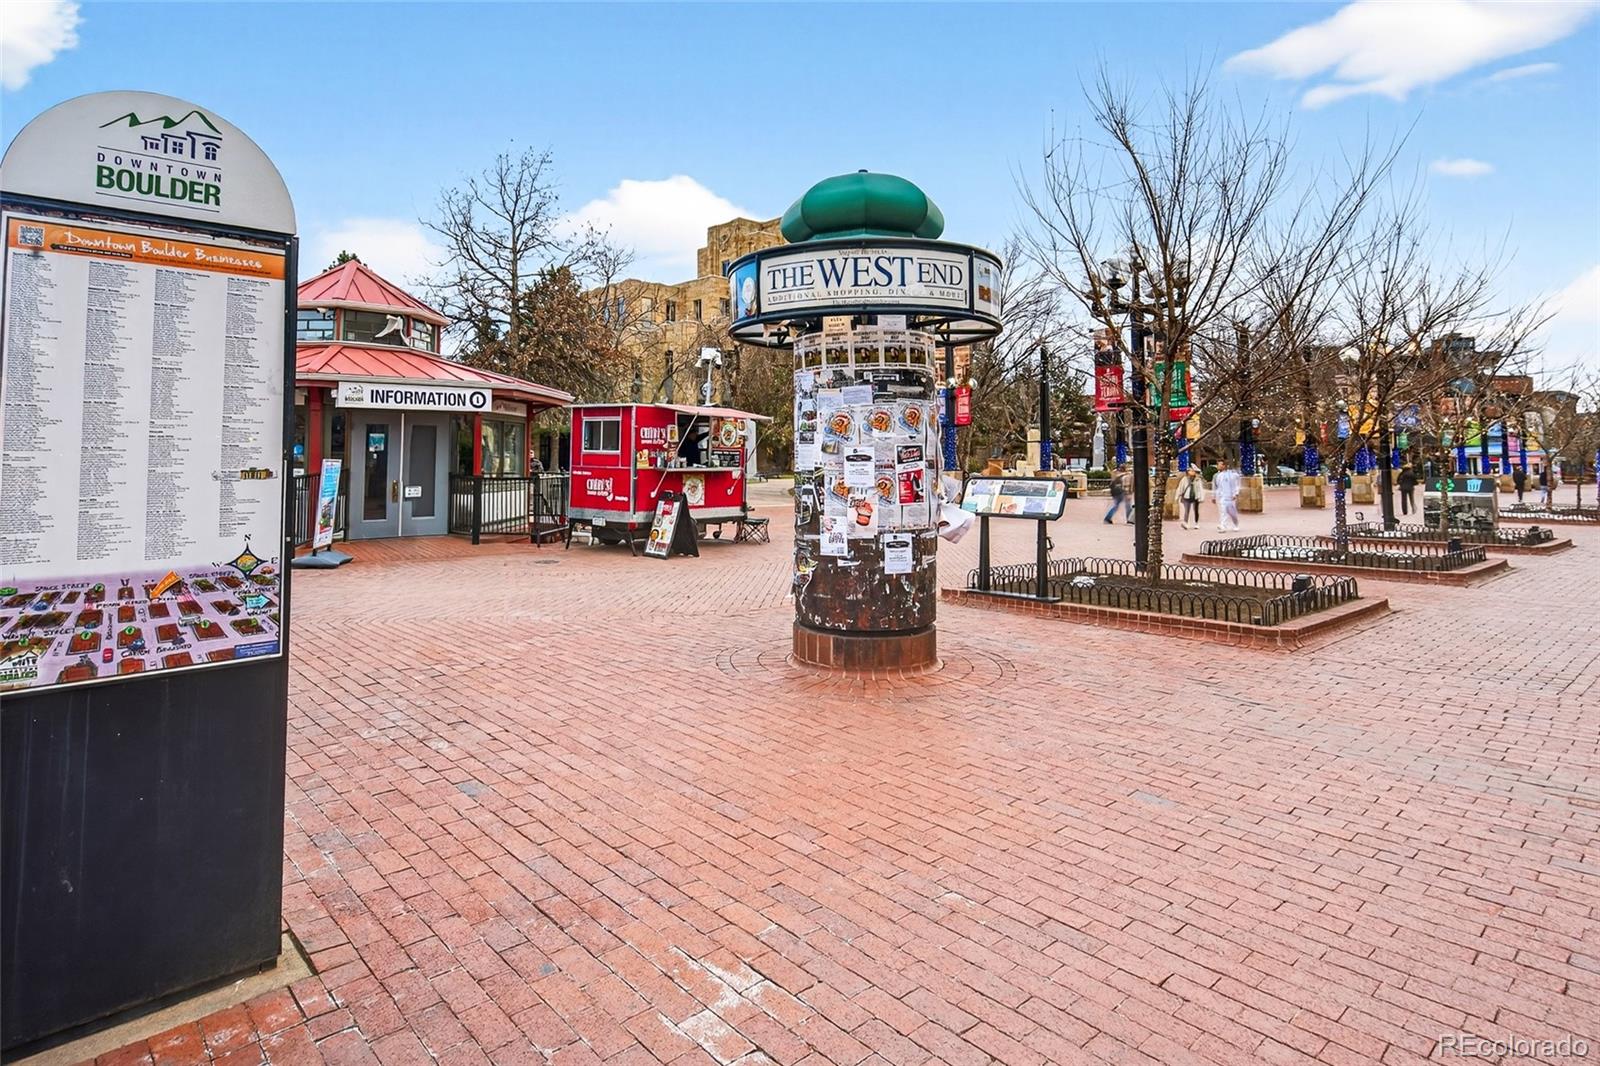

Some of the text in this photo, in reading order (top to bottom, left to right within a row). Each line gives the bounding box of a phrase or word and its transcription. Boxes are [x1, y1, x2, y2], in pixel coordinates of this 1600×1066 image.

[97, 152, 222, 183] DOWNTOWN
[96, 164, 221, 207] BOULDER
[64, 231, 137, 252] Downtown
[141, 240, 190, 259] Boulder
[195, 247, 262, 268] Businesses
[767, 255, 963, 290] THE WEST END
[370, 388, 467, 407] INFORMATION
[244, 533, 252, 542] N
